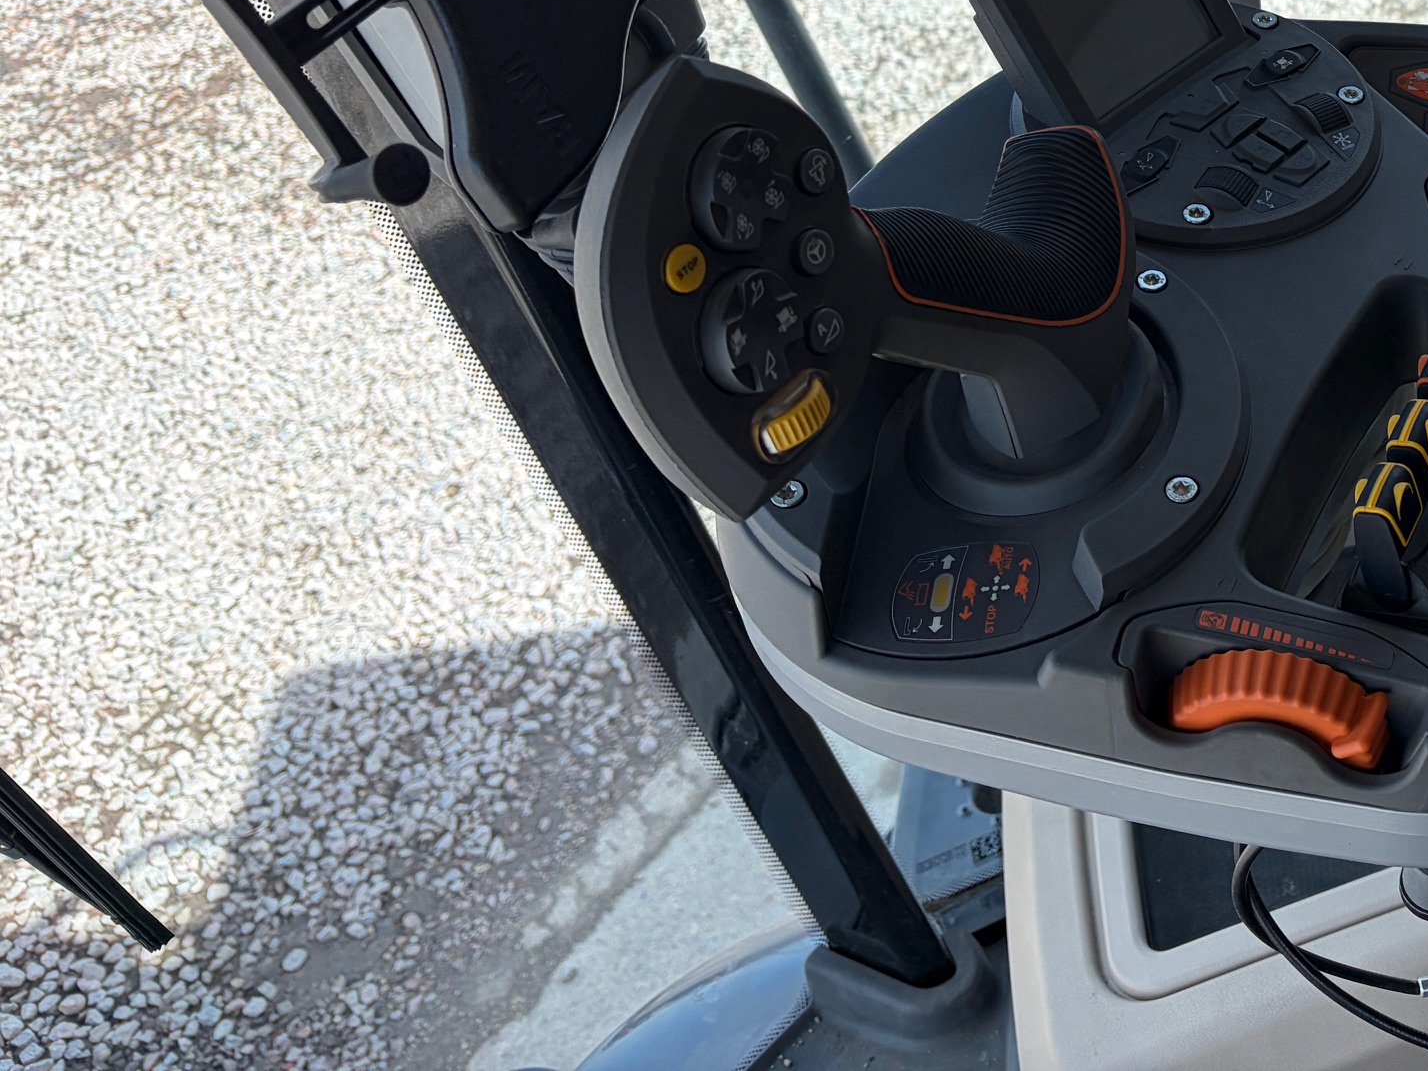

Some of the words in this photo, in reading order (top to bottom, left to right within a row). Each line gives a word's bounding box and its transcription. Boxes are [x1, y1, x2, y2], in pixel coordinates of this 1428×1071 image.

[676, 255, 699, 281] STOP
[1003, 546, 1015, 570] AUTO
[984, 604, 998, 634] STOP
